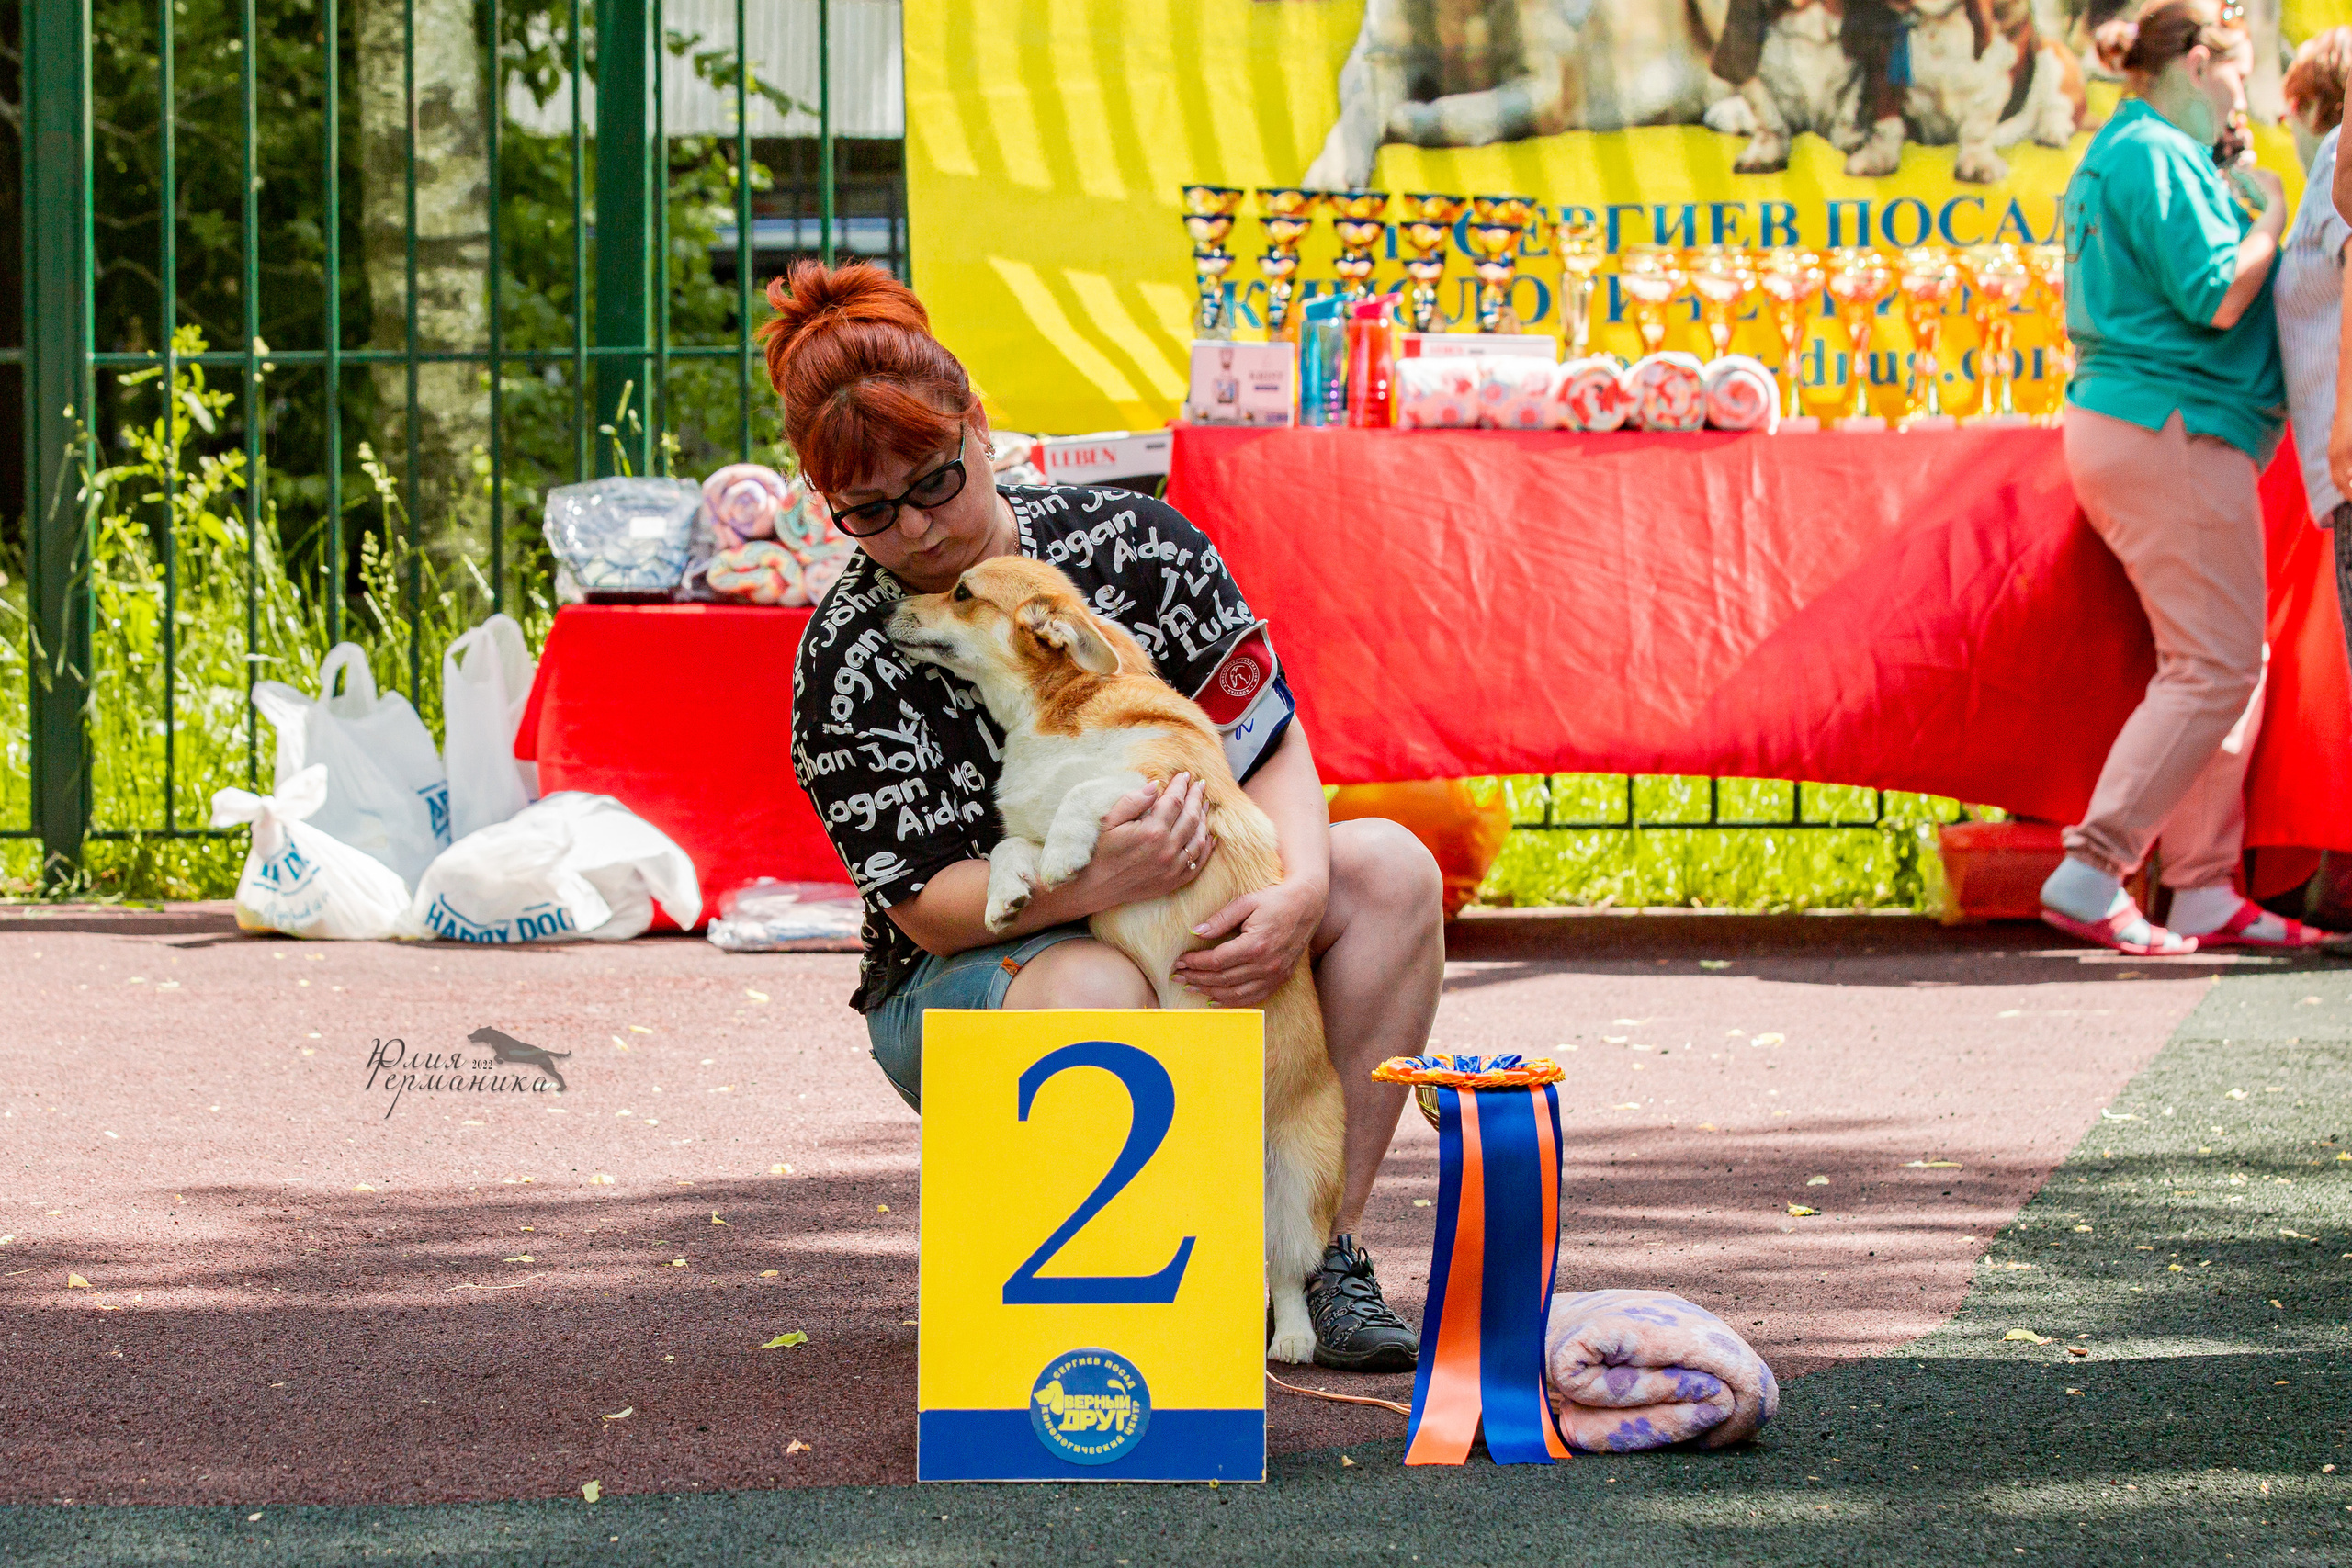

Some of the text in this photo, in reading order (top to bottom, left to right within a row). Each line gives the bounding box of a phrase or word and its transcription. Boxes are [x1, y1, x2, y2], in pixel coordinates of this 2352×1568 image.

[1050, 446, 1116, 468] LEBEN
[1002, 1041, 1197, 1305] 2
[1052, 1357, 1136, 1390] СЕРГИЕВ ПОСАД
[1064, 1394, 1131, 1409] ВЕРНЫЙ
[1041, 1400, 1141, 1455] КИНОЛОГИЧЕСКИЙ ЦЕНТР
[1057, 1409, 1131, 1431] ДРУГ
